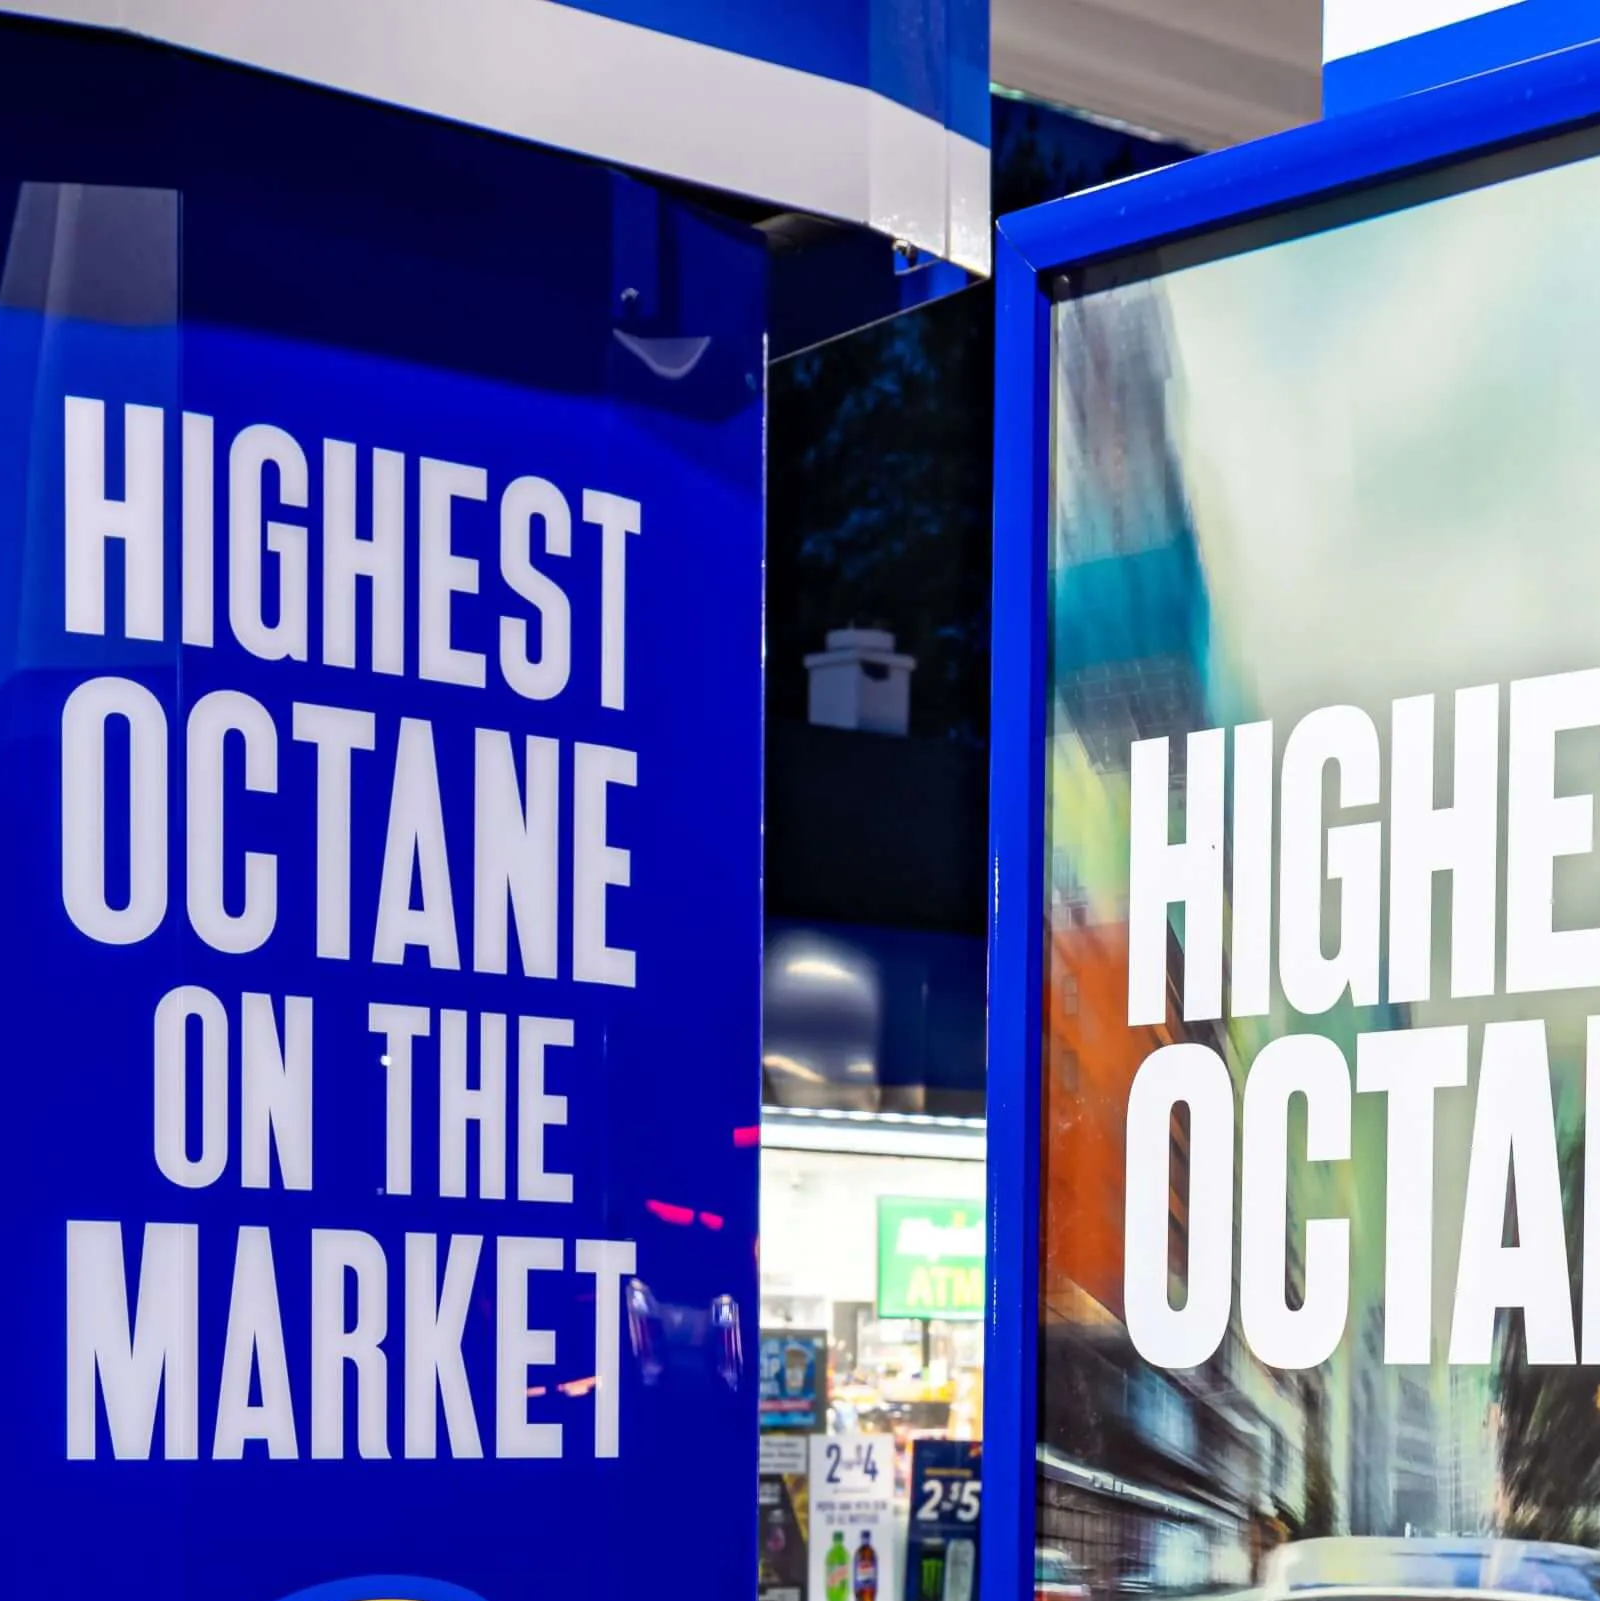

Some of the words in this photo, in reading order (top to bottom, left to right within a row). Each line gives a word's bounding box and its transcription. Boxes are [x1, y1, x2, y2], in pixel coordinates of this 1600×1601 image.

[64, 394, 641, 711] HIGHEST
[61, 676, 638, 989] OCTANE
[153, 985, 313, 1191] ON
[368, 1001, 574, 1203] THE
[66, 1220, 637, 1461] MARKET
[906, 1265, 983, 1308] ATM
[826, 1443, 842, 1484] 2
[916, 1480, 943, 1521] 2
